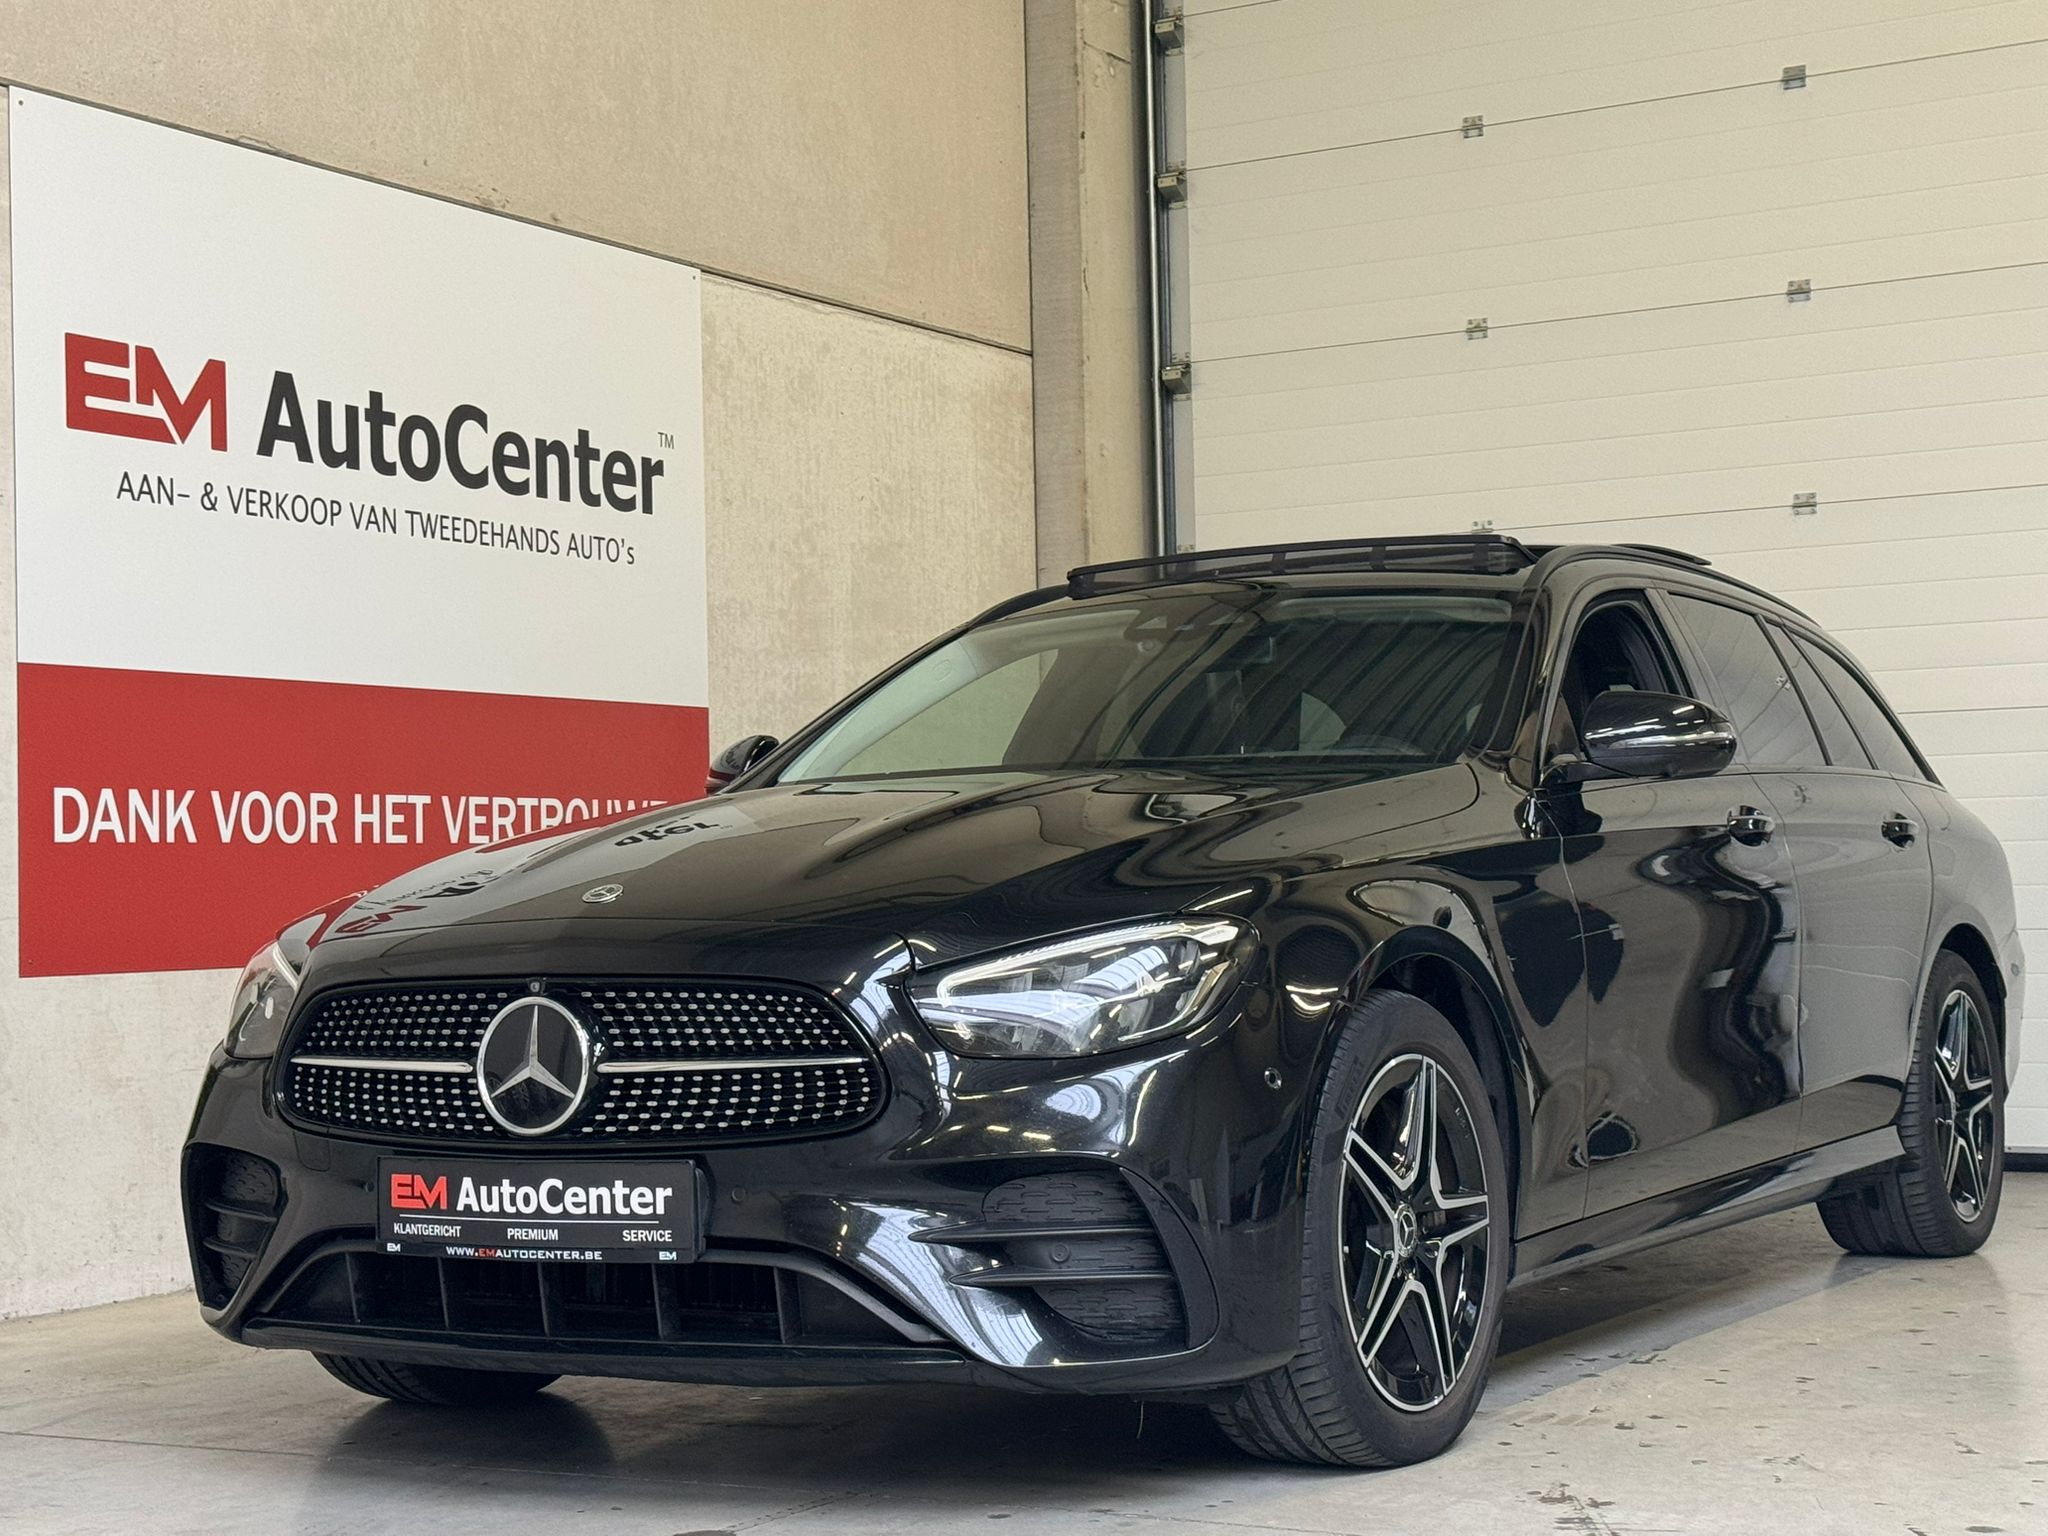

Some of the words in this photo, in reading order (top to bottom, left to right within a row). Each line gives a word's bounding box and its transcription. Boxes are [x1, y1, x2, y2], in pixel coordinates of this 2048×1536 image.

[65, 332, 228, 452] EM
[256, 370, 665, 516] AutoCenter
[117, 471, 190, 506] AAN-
[200, 482, 218, 511] &
[227, 485, 342, 527] VERKOOP
[350, 502, 397, 535] VAN
[405, 510, 560, 555] TWEEDEHANDS
[53, 787, 198, 843] DANK
[210, 790, 339, 844] VOOR
[354, 793, 432, 844] HET
[391, 1174, 447, 1210] EM
[456, 1177, 672, 1216] AutoCenter
[393, 1222, 462, 1238] KLANTGERICHT
[507, 1227, 559, 1241] PREMIUM
[622, 1229, 673, 1242] SERVICE
[446, 1246, 603, 1261] WWW.EMAUTOCENTER.BE
[658, 1250, 677, 1261] EM
